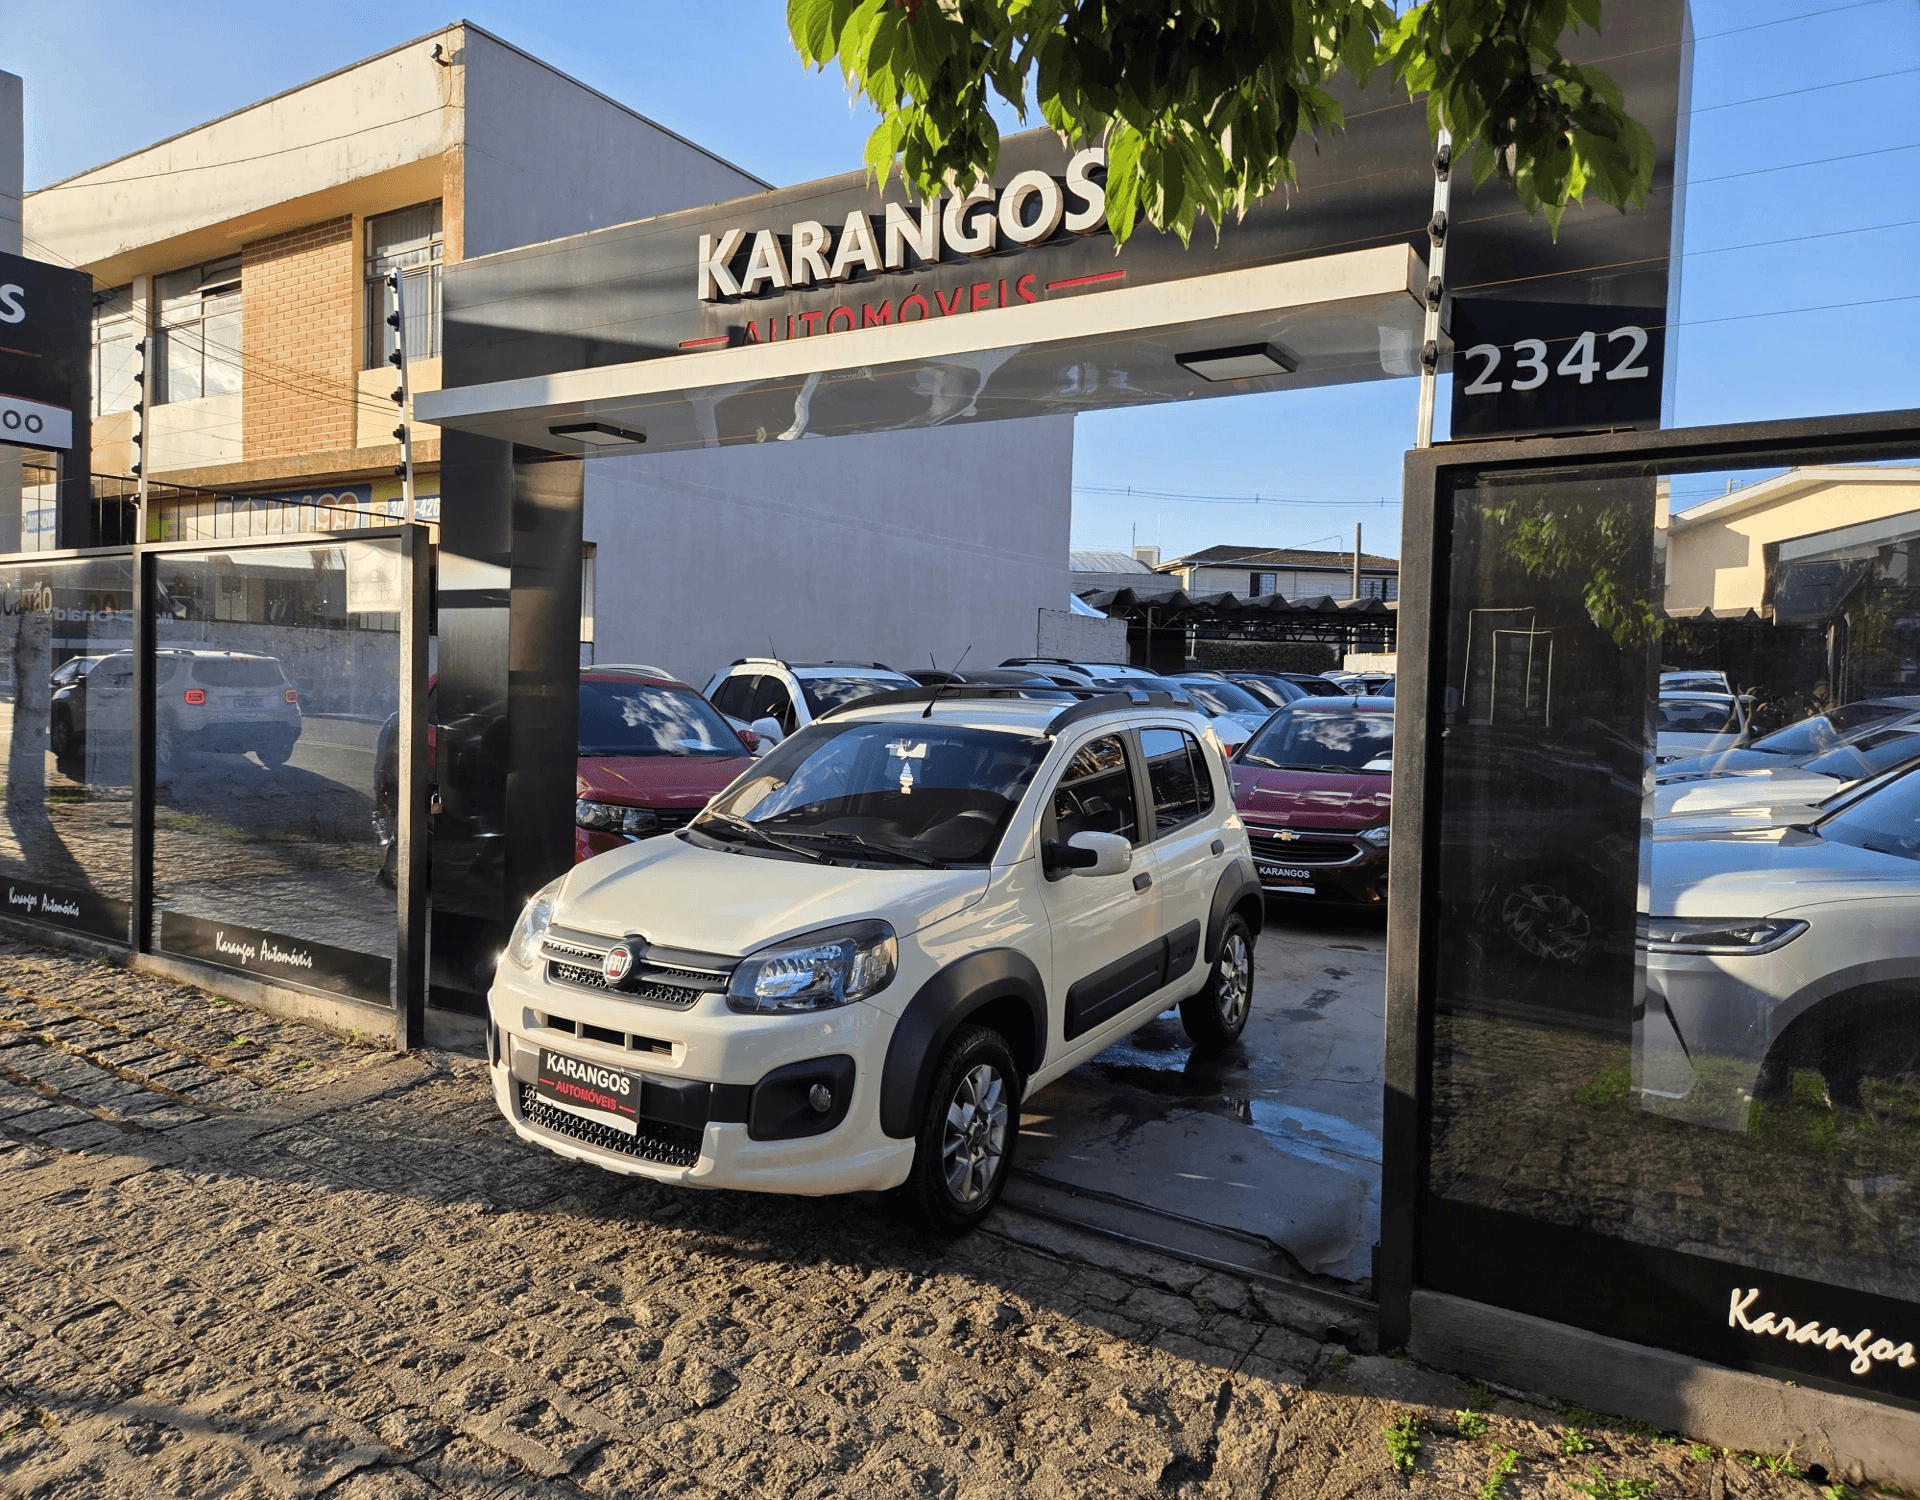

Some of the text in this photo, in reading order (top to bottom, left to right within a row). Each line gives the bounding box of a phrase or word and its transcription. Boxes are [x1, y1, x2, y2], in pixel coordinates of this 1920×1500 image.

[698, 147, 1106, 301] KARANGOS
[743, 273, 1037, 346] AUTOMÓVEIS
[1464, 326, 1649, 395] 2342
[1259, 866, 1311, 879] KARANGOS
[9, 887, 80, 917] Karangos Automóveis
[216, 931, 313, 969] Karangos Automóveis
[609, 955, 627, 971] FIAT
[546, 1053, 631, 1096] KARANGOS
[556, 1081, 617, 1112] AUTOMÓVEIS
[1729, 1288, 1917, 1375] Karangos
